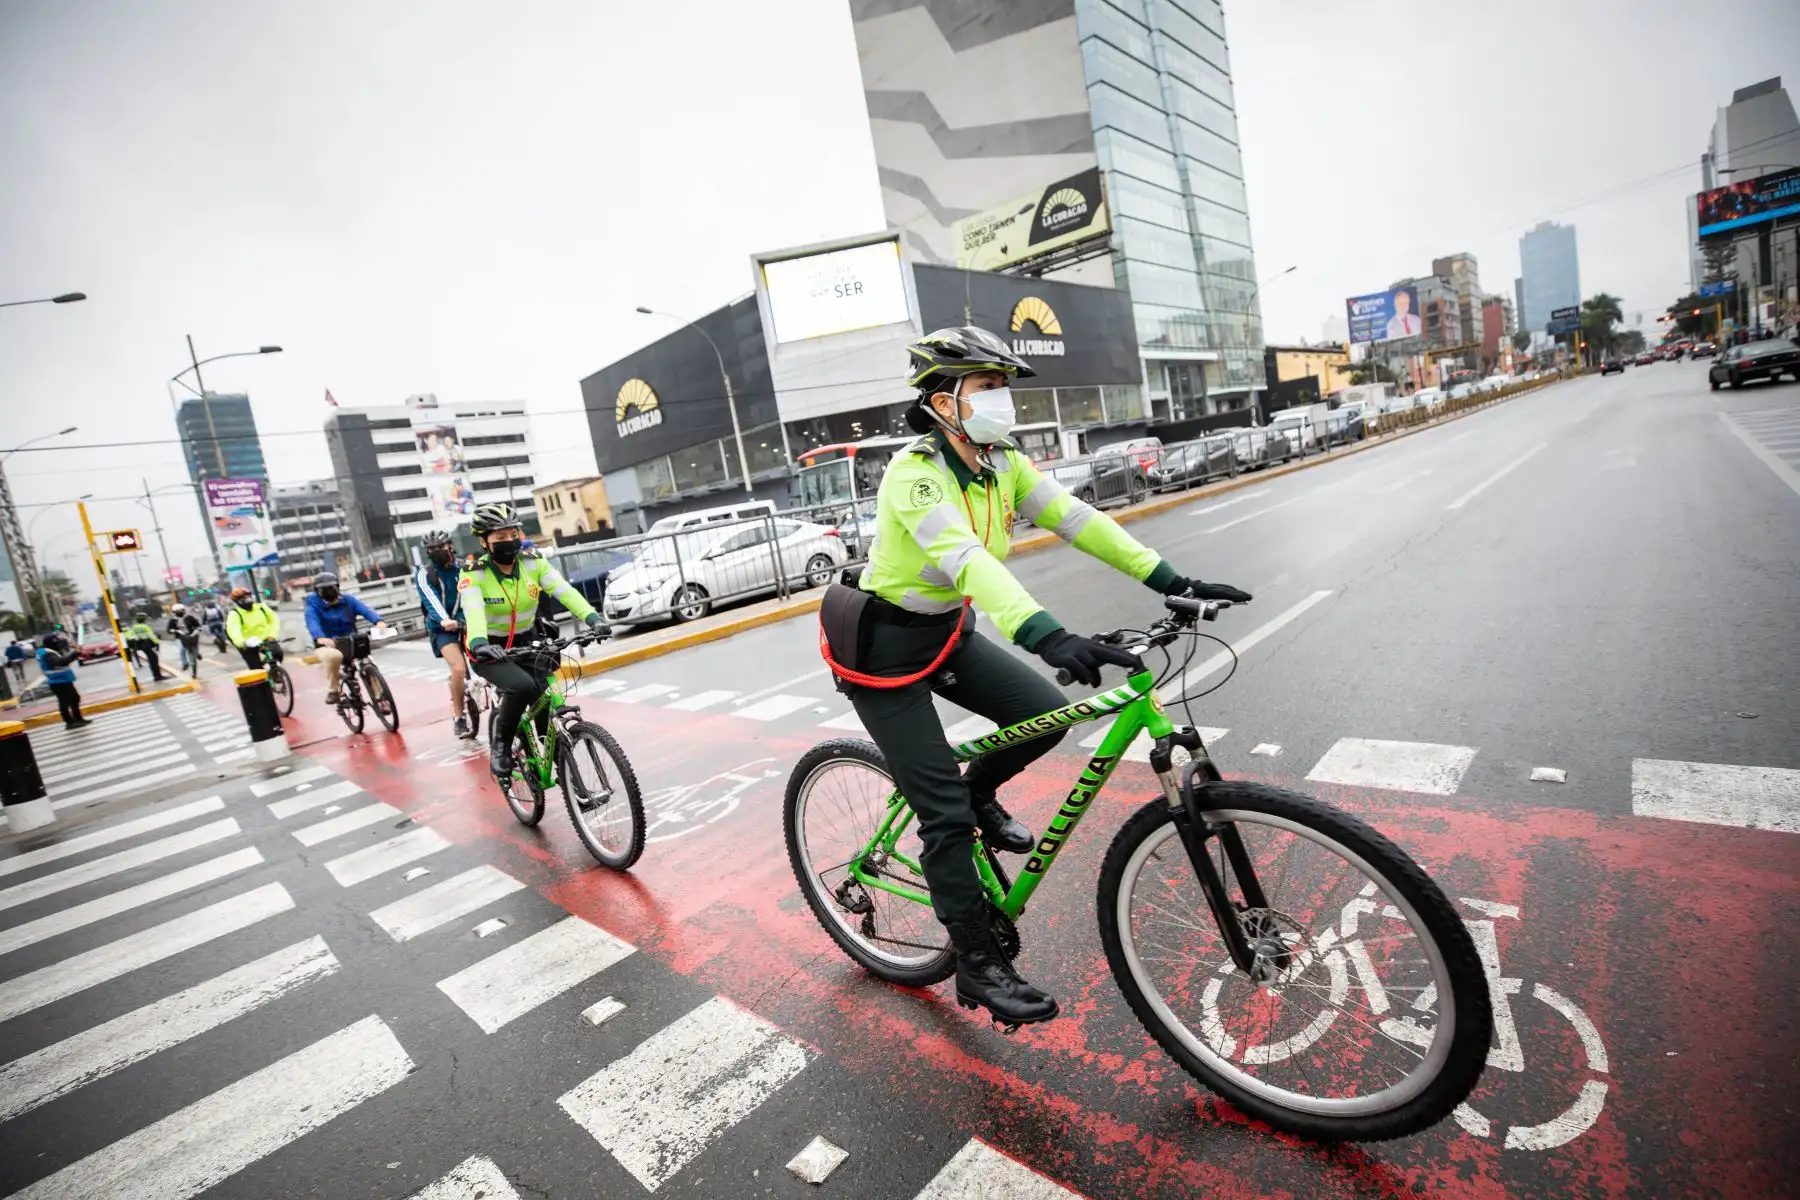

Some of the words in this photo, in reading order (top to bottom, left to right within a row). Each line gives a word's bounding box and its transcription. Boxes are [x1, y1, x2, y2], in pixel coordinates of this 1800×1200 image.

[1042, 215, 1053, 227] LA
[963, 227, 987, 242] COMO
[964, 238, 981, 251] QUE
[834, 281, 864, 298] SER
[1012, 339, 1026, 356] LA
[1026, 339, 1065, 356] CURACAO
[616, 421, 628, 438] LA
[627, 409, 662, 434] CURACAO
[973, 701, 1097, 751] TRANSITO
[1024, 755, 1118, 874] POLICIA
